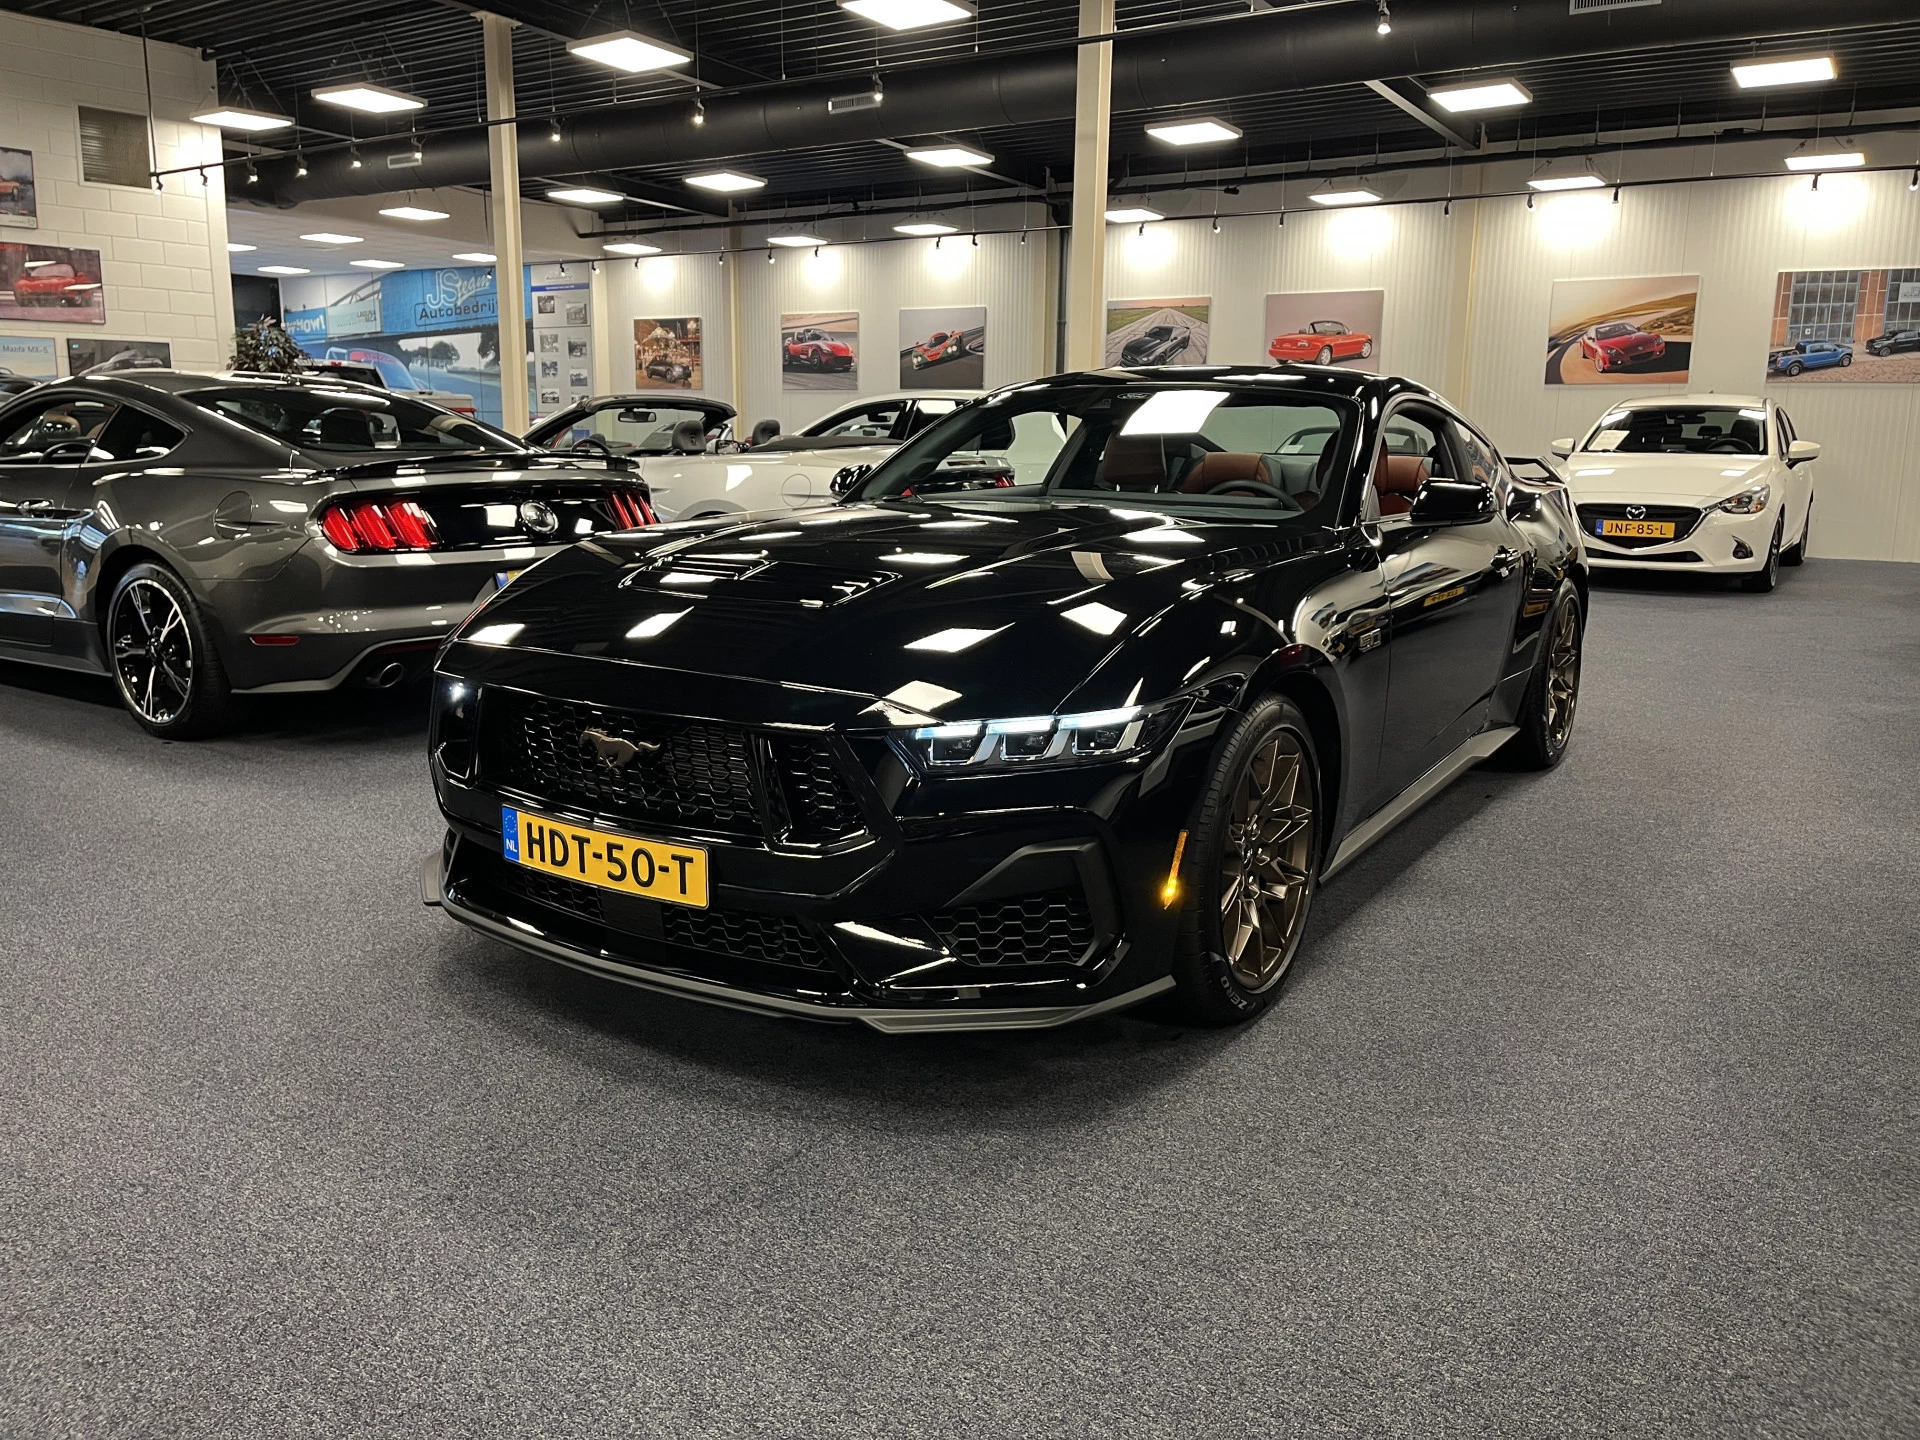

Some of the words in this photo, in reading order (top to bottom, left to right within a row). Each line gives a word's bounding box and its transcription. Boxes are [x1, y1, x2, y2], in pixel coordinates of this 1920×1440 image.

[419, 298, 498, 321] Autobedrij
[2, 345, 26, 353] Mazda
[27, 346, 49, 354] MX-5
[1607, 522, 1666, 536] JNF-85-L
[505, 837, 519, 853] NL
[526, 821, 694, 895] HDT-50-T
[1220, 975, 1248, 1010] ZERO
